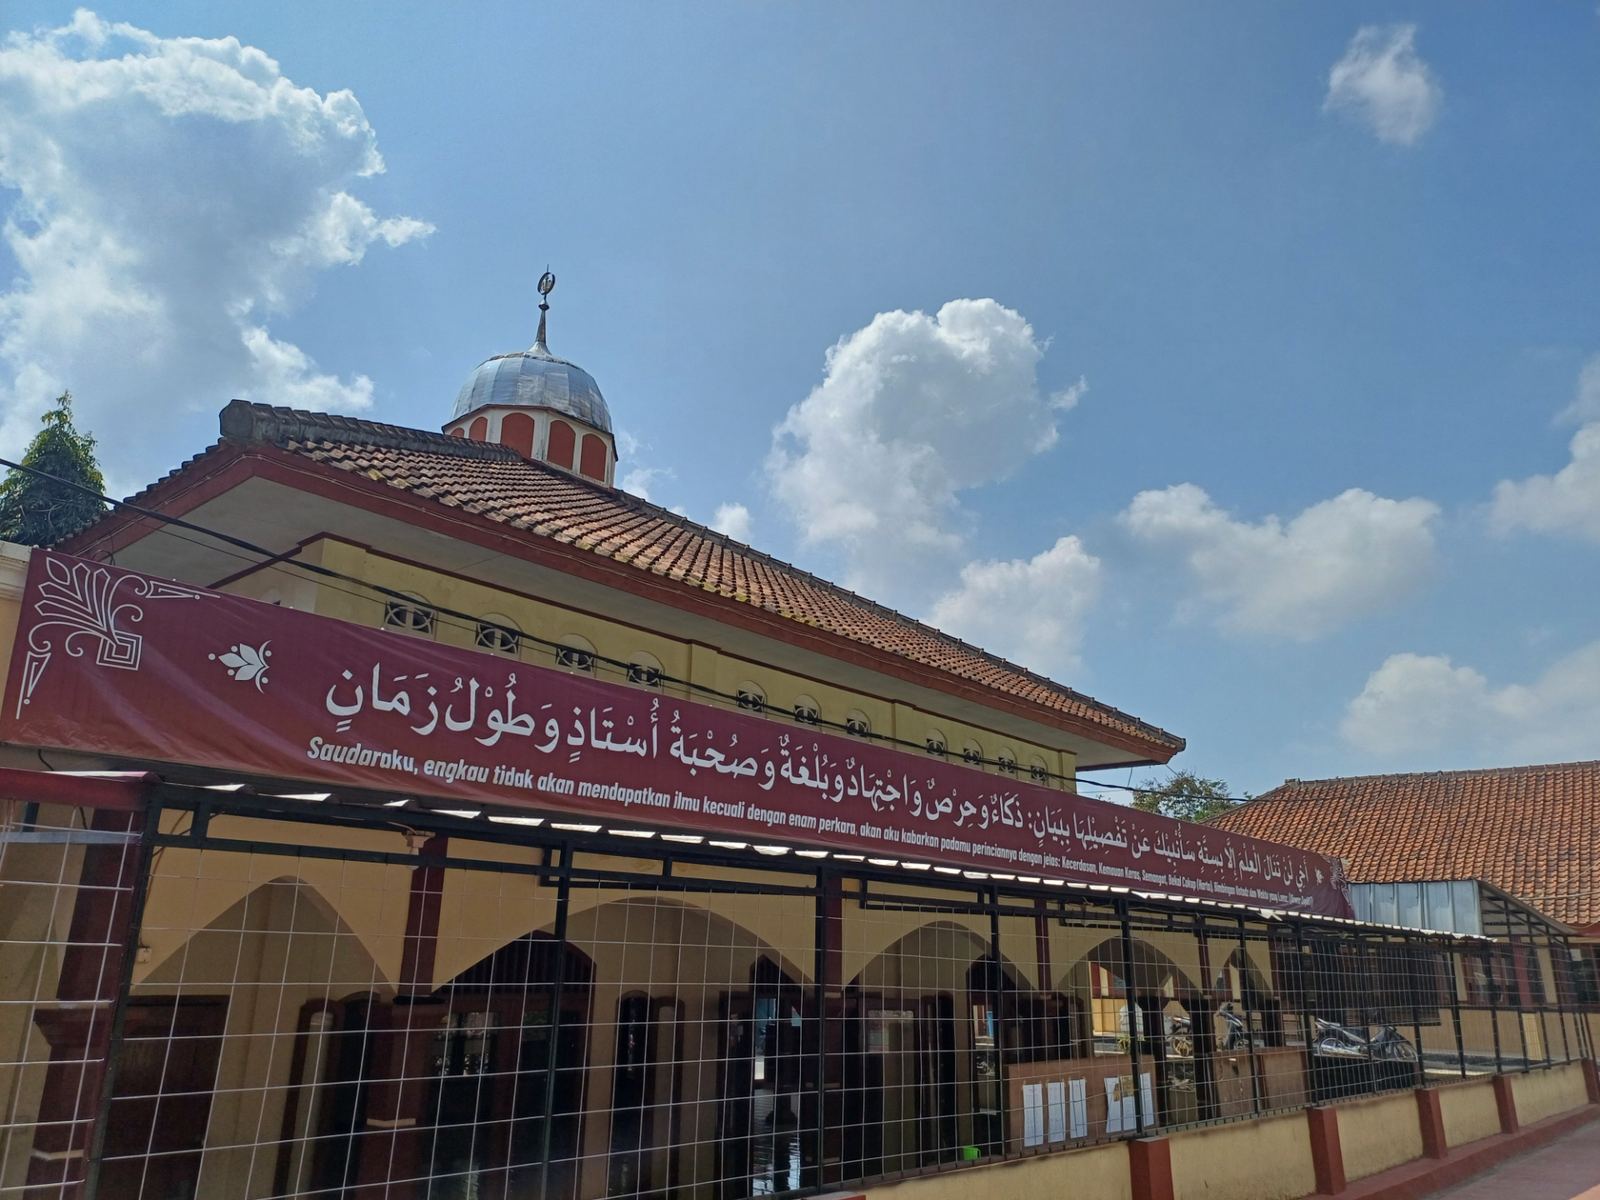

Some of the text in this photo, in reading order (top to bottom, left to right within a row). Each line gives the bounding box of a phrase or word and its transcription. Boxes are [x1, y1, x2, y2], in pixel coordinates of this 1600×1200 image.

[306, 735, 419, 776] Saudaraku,
[423, 757, 490, 784] engkau
[493, 764, 534, 790] tidak
[537, 774, 575, 796] akan
[577, 782, 671, 807] mendapatkan
[672, 791, 701, 813] ilmu
[702, 796, 746, 820] kecuali
[747, 804, 787, 828] dengan
[788, 814, 818, 830] enam
[818, 818, 858, 837] perkara,
[860, 823, 882, 838] akan
[883, 826, 900, 842] aku
[901, 828, 939, 848] kabarkan
[940, 836, 972, 854] padamu
[972, 841, 1017, 863] perinciannya
[1018, 847, 1042, 866] dengan
